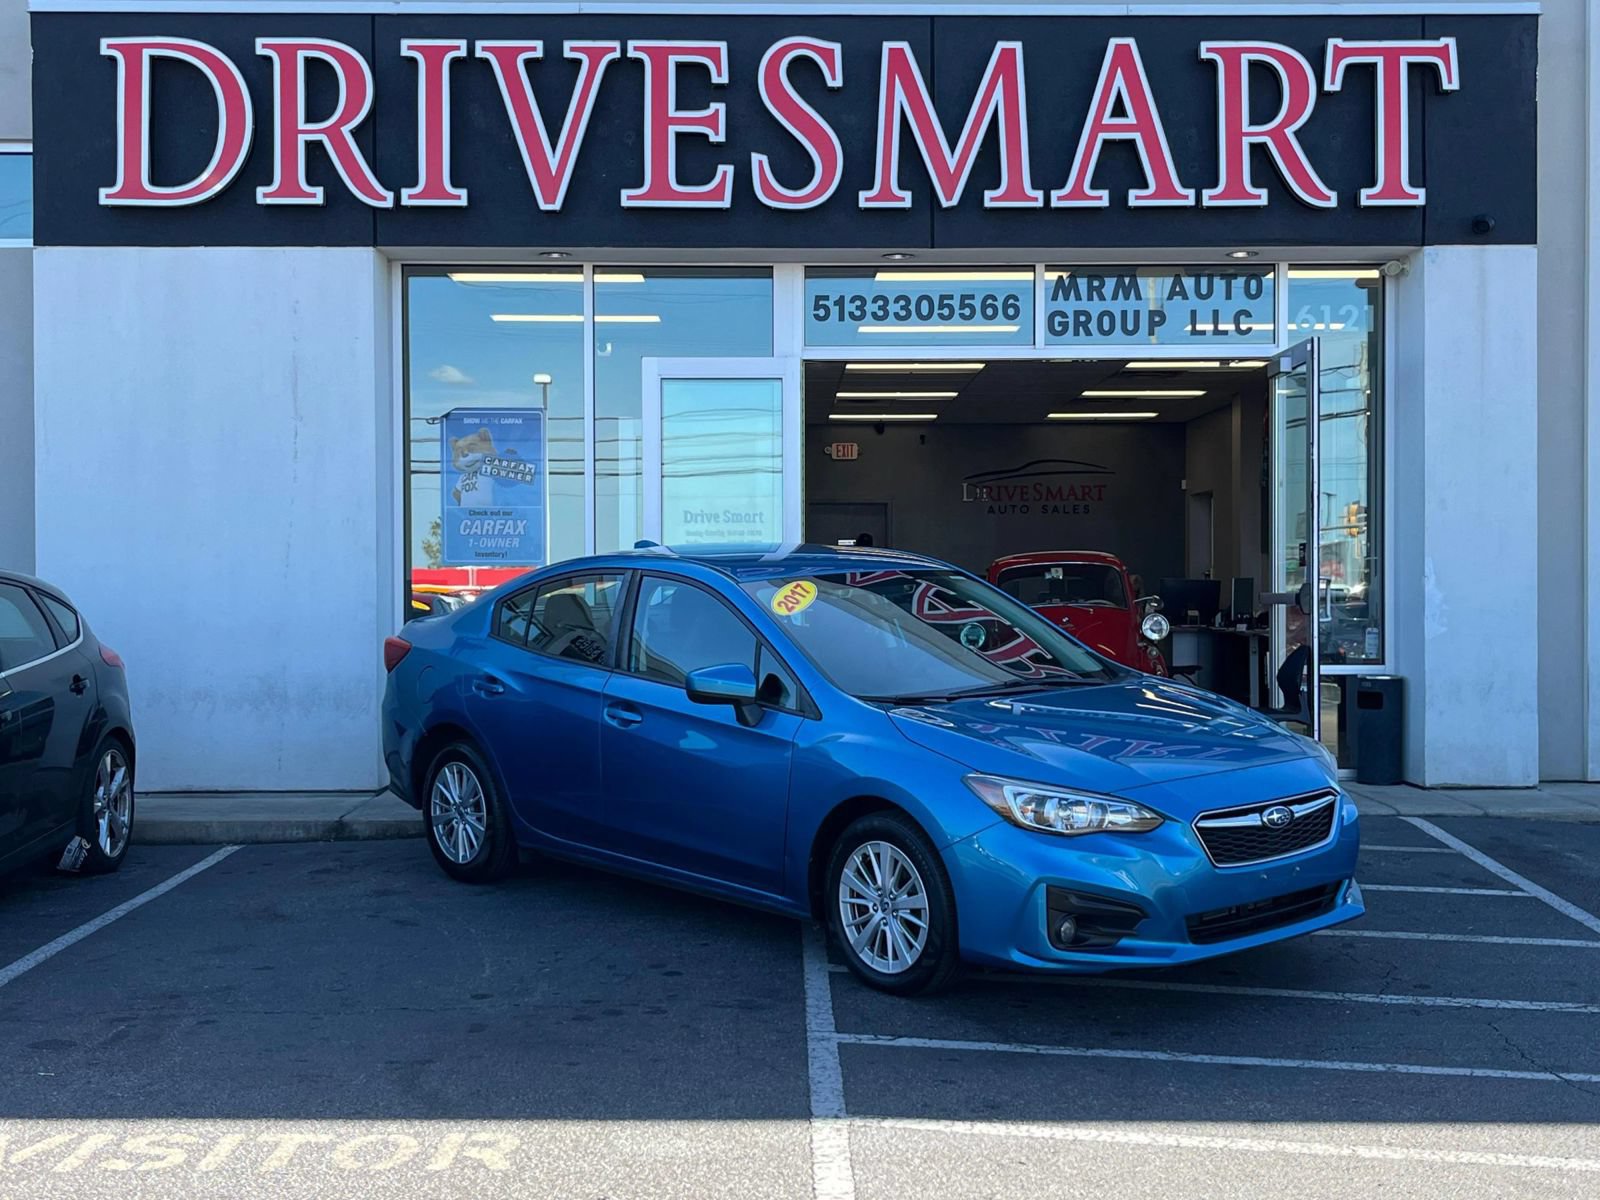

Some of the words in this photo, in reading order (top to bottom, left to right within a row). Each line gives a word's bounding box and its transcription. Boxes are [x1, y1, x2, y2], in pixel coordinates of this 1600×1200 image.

[99, 36, 1460, 211] DRIVESMART
[1051, 274, 1142, 301] MRM
[1167, 272, 1264, 301] AUTO
[812, 294, 1021, 322] 5133305566
[1047, 309, 1167, 336] GROUP
[1189, 309, 1254, 336] LLC
[836, 444, 854, 458] EXIT
[484, 457, 536, 474] CARFAX
[683, 509, 720, 524] Drive
[723, 510, 765, 524] Smart
[987, 504, 1030, 515] AUTO
[1041, 504, 1090, 515] SALES
[460, 520, 527, 535] CARFAX
[468, 538, 520, 548] 1-OWNER
[777, 583, 811, 612] 2017
